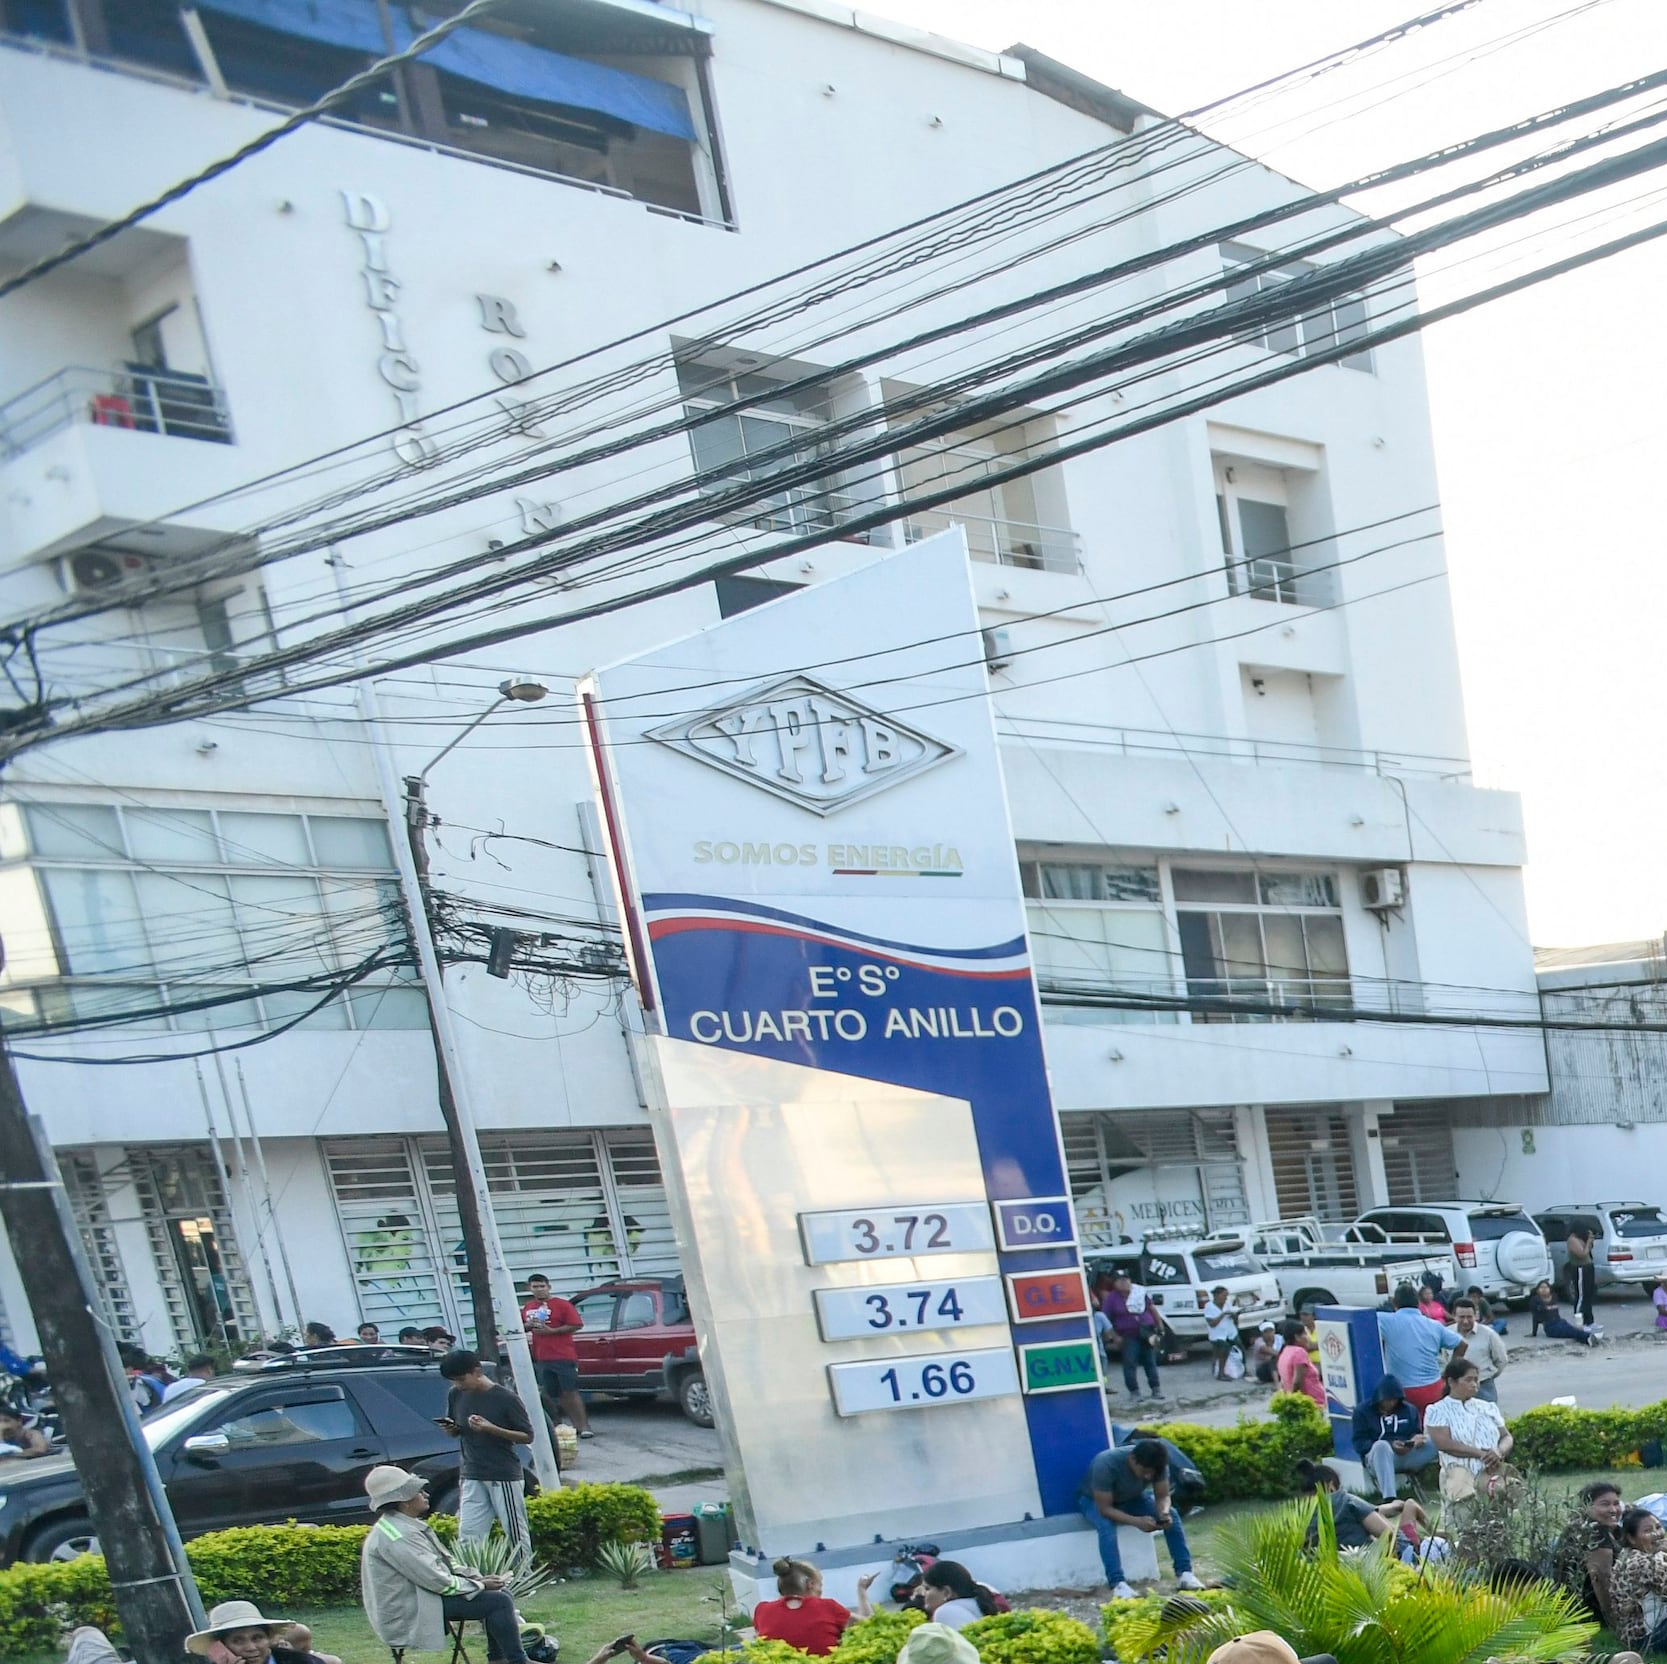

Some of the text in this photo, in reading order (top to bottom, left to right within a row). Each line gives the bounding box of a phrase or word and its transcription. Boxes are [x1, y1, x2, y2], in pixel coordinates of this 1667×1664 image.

[714, 698, 902, 784] YPFB
[693, 841, 964, 869] SOMOS ENERGÍA
[689, 1005, 1024, 1044] CUARTO ANILLO
[851, 1213, 952, 1254] 3.72
[1012, 1213, 1062, 1235] D.O.
[1149, 1258, 1177, 1280] VIP
[865, 1287, 964, 1329] 3.74
[880, 1360, 976, 1402] 1.66
[1029, 1353, 1096, 1379] G.N.V.
